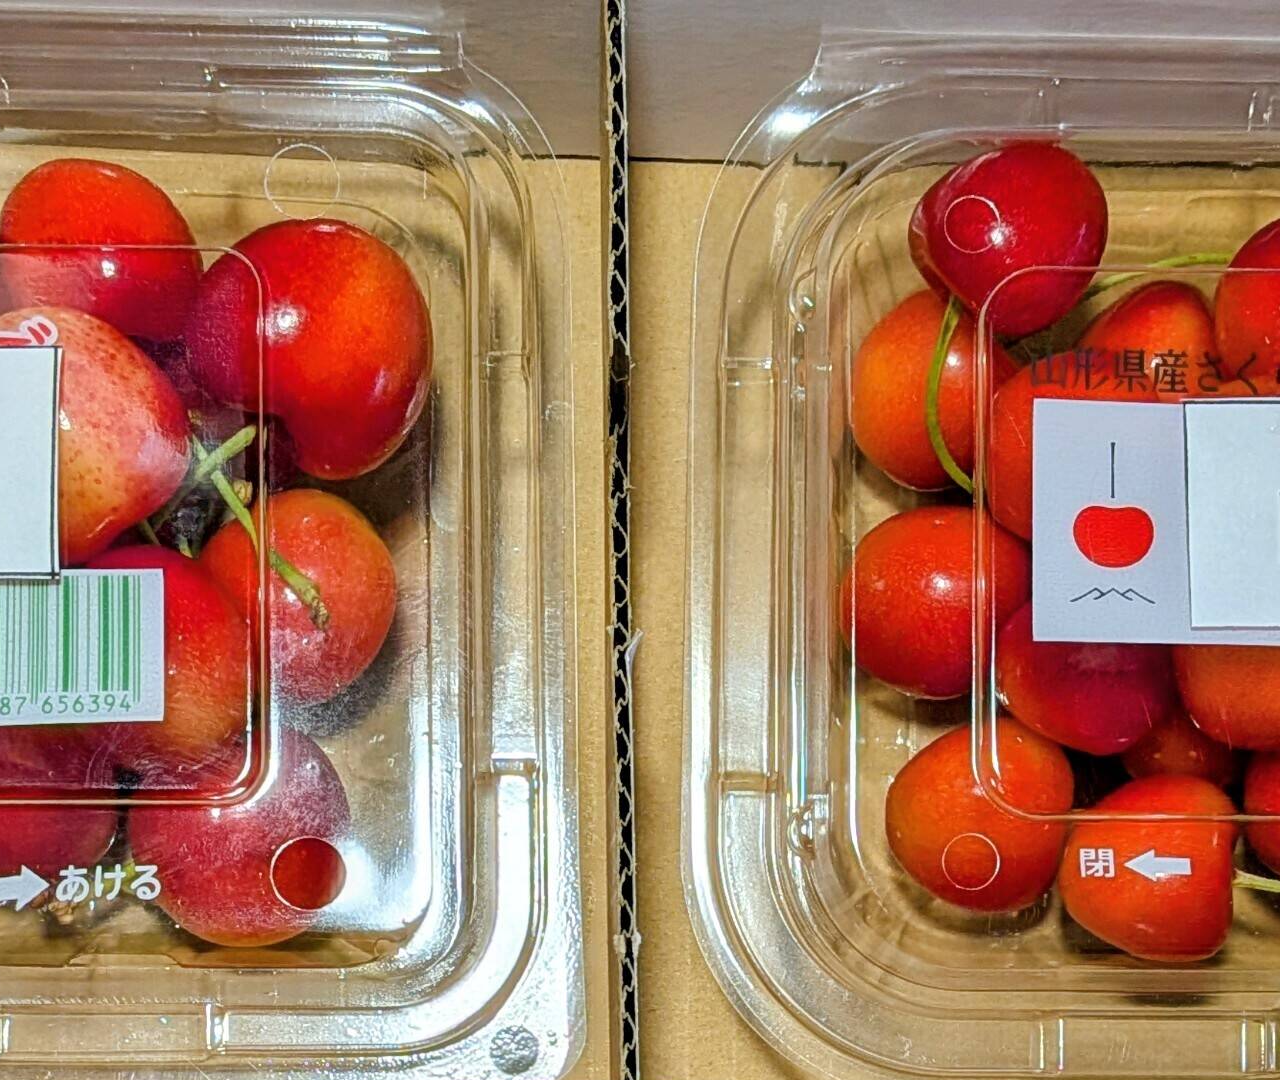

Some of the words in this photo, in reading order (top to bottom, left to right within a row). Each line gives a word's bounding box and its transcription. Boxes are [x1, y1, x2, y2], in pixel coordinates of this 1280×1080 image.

[1079, 848, 1115, 878] 閉
[55, 862, 162, 904] あける
